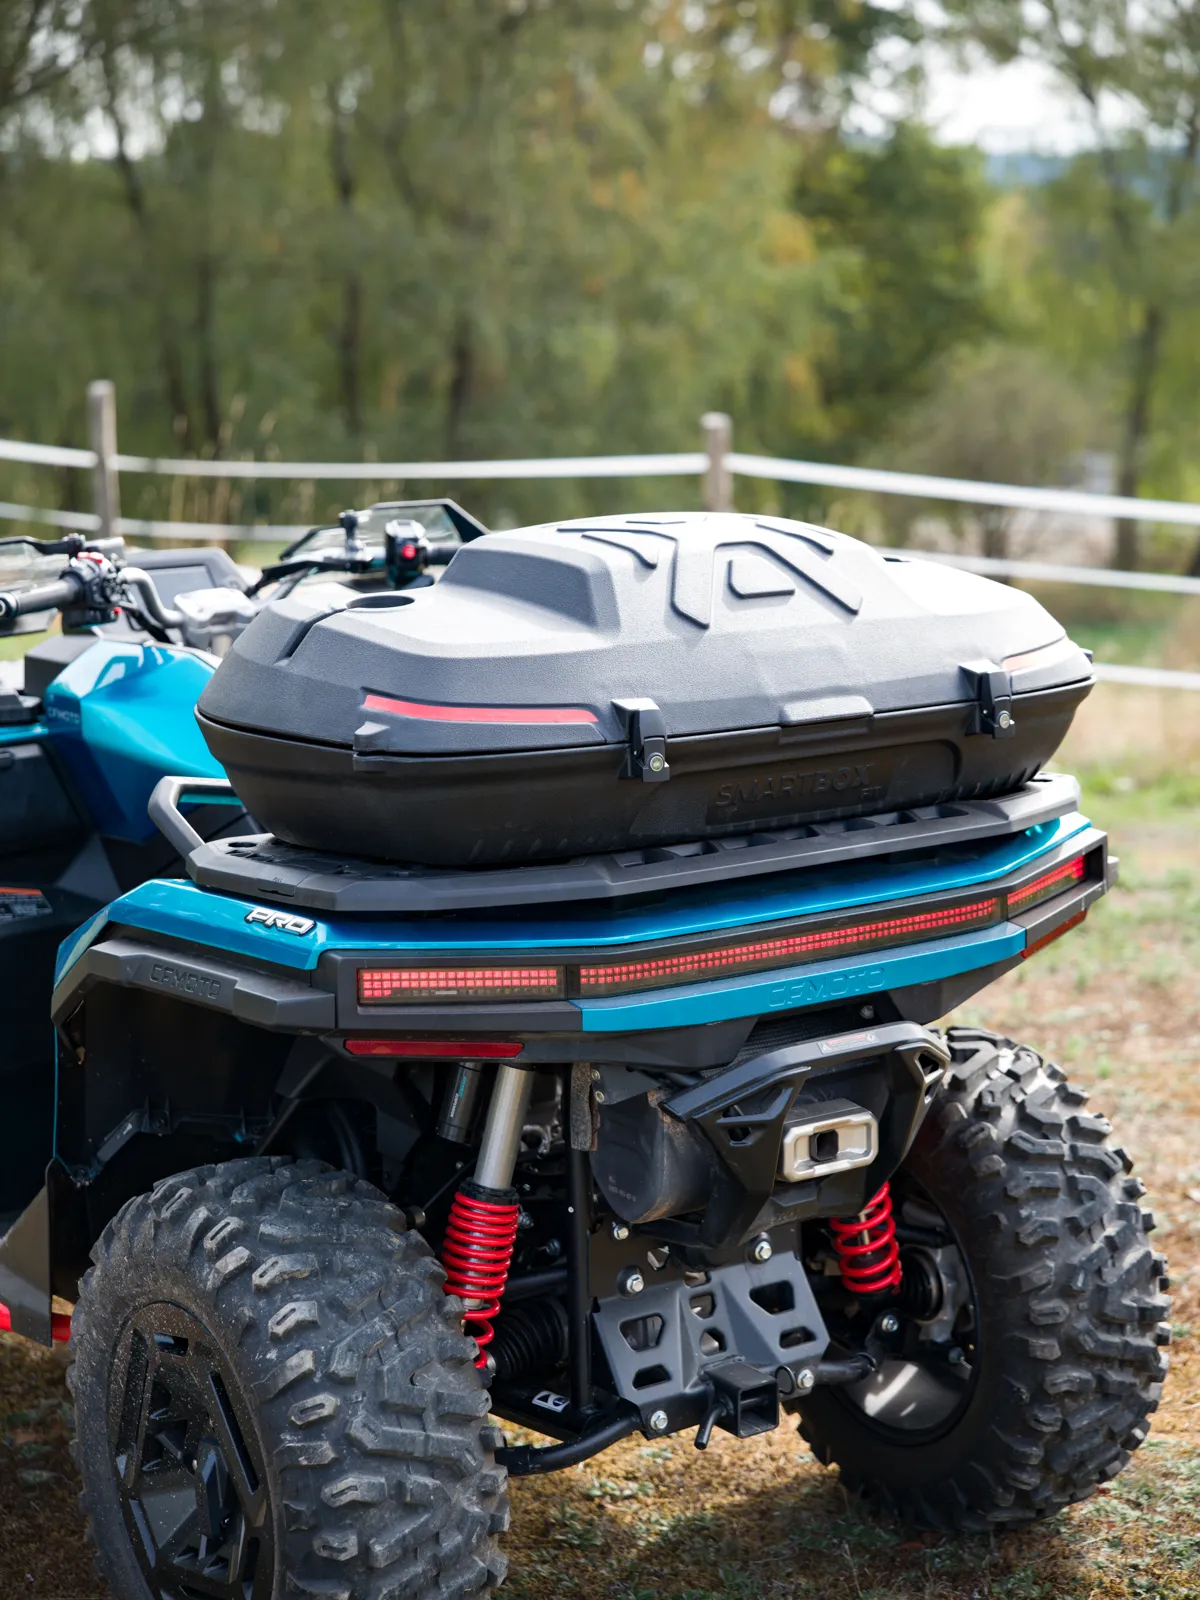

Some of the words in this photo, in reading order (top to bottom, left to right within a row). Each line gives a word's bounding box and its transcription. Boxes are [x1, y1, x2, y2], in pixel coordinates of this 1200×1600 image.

[715, 763, 874, 806] SMARTBOX
[244, 906, 317, 937] PRO
[149, 964, 221, 999] CFMOTO
[769, 966, 885, 1007] CFMOTO
